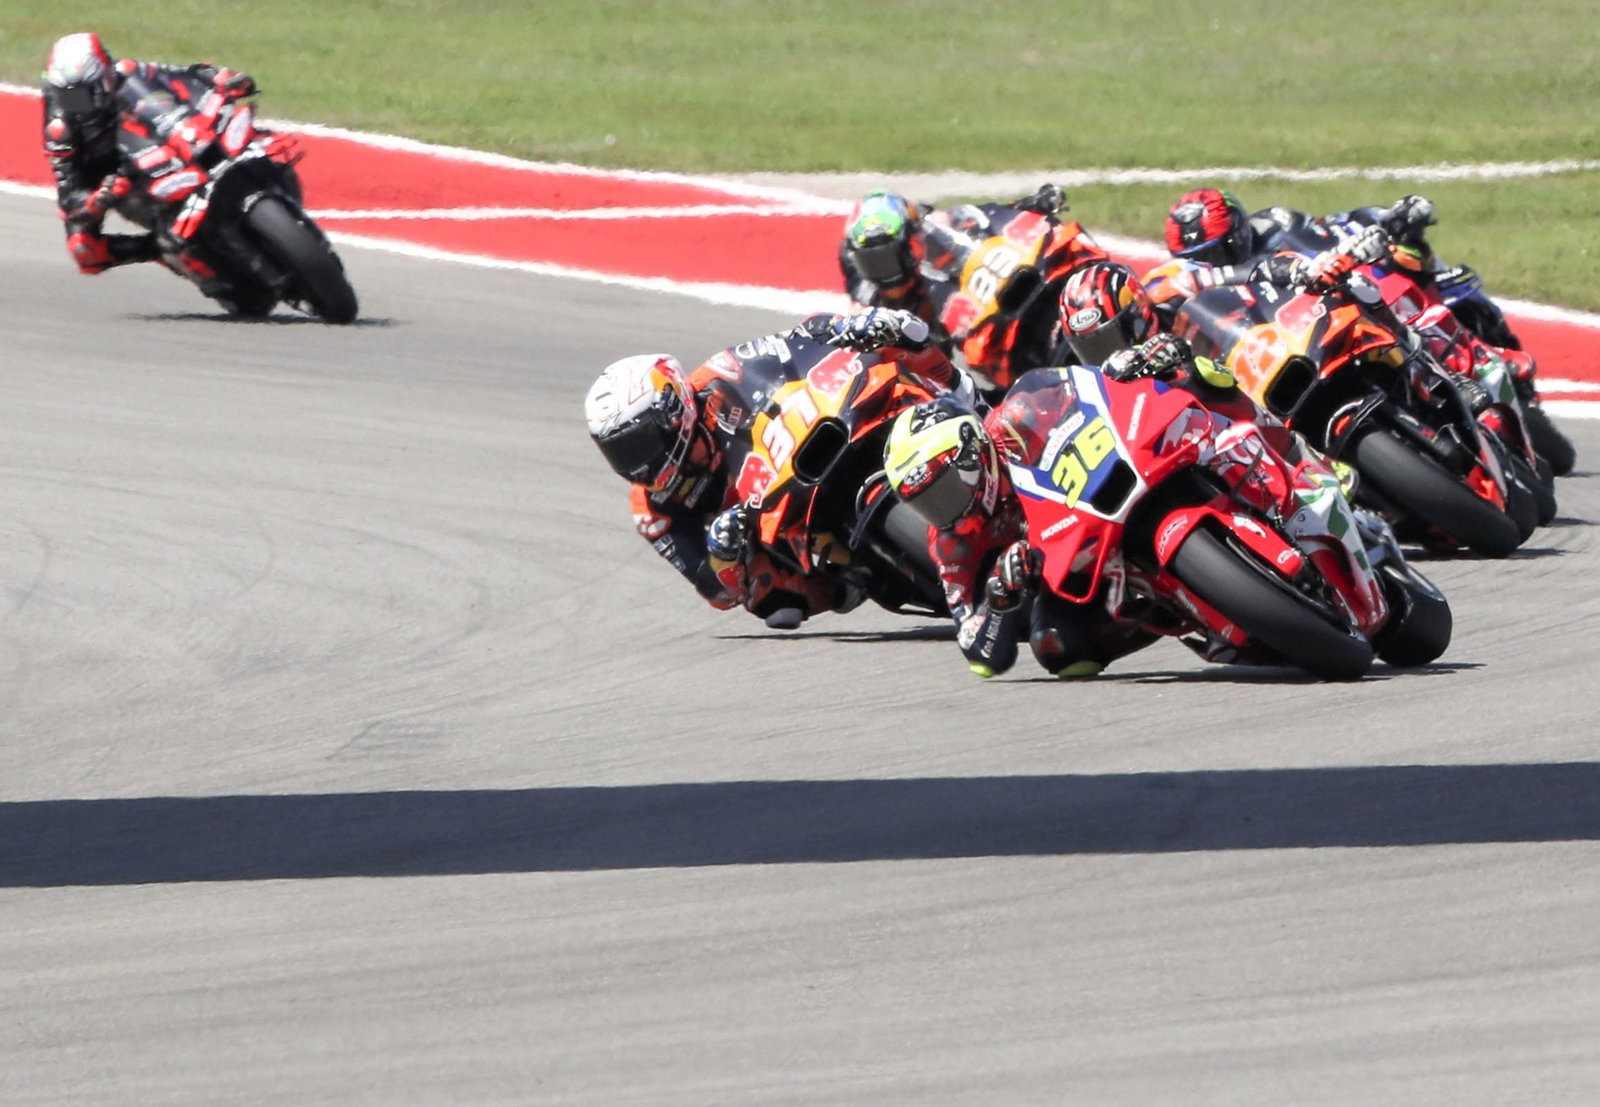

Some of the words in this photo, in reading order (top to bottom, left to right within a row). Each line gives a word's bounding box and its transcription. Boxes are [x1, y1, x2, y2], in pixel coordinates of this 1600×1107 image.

[967, 245, 1020, 305] 33
[1051, 415, 1116, 510] 36
[1040, 513, 1079, 541] HONDA
